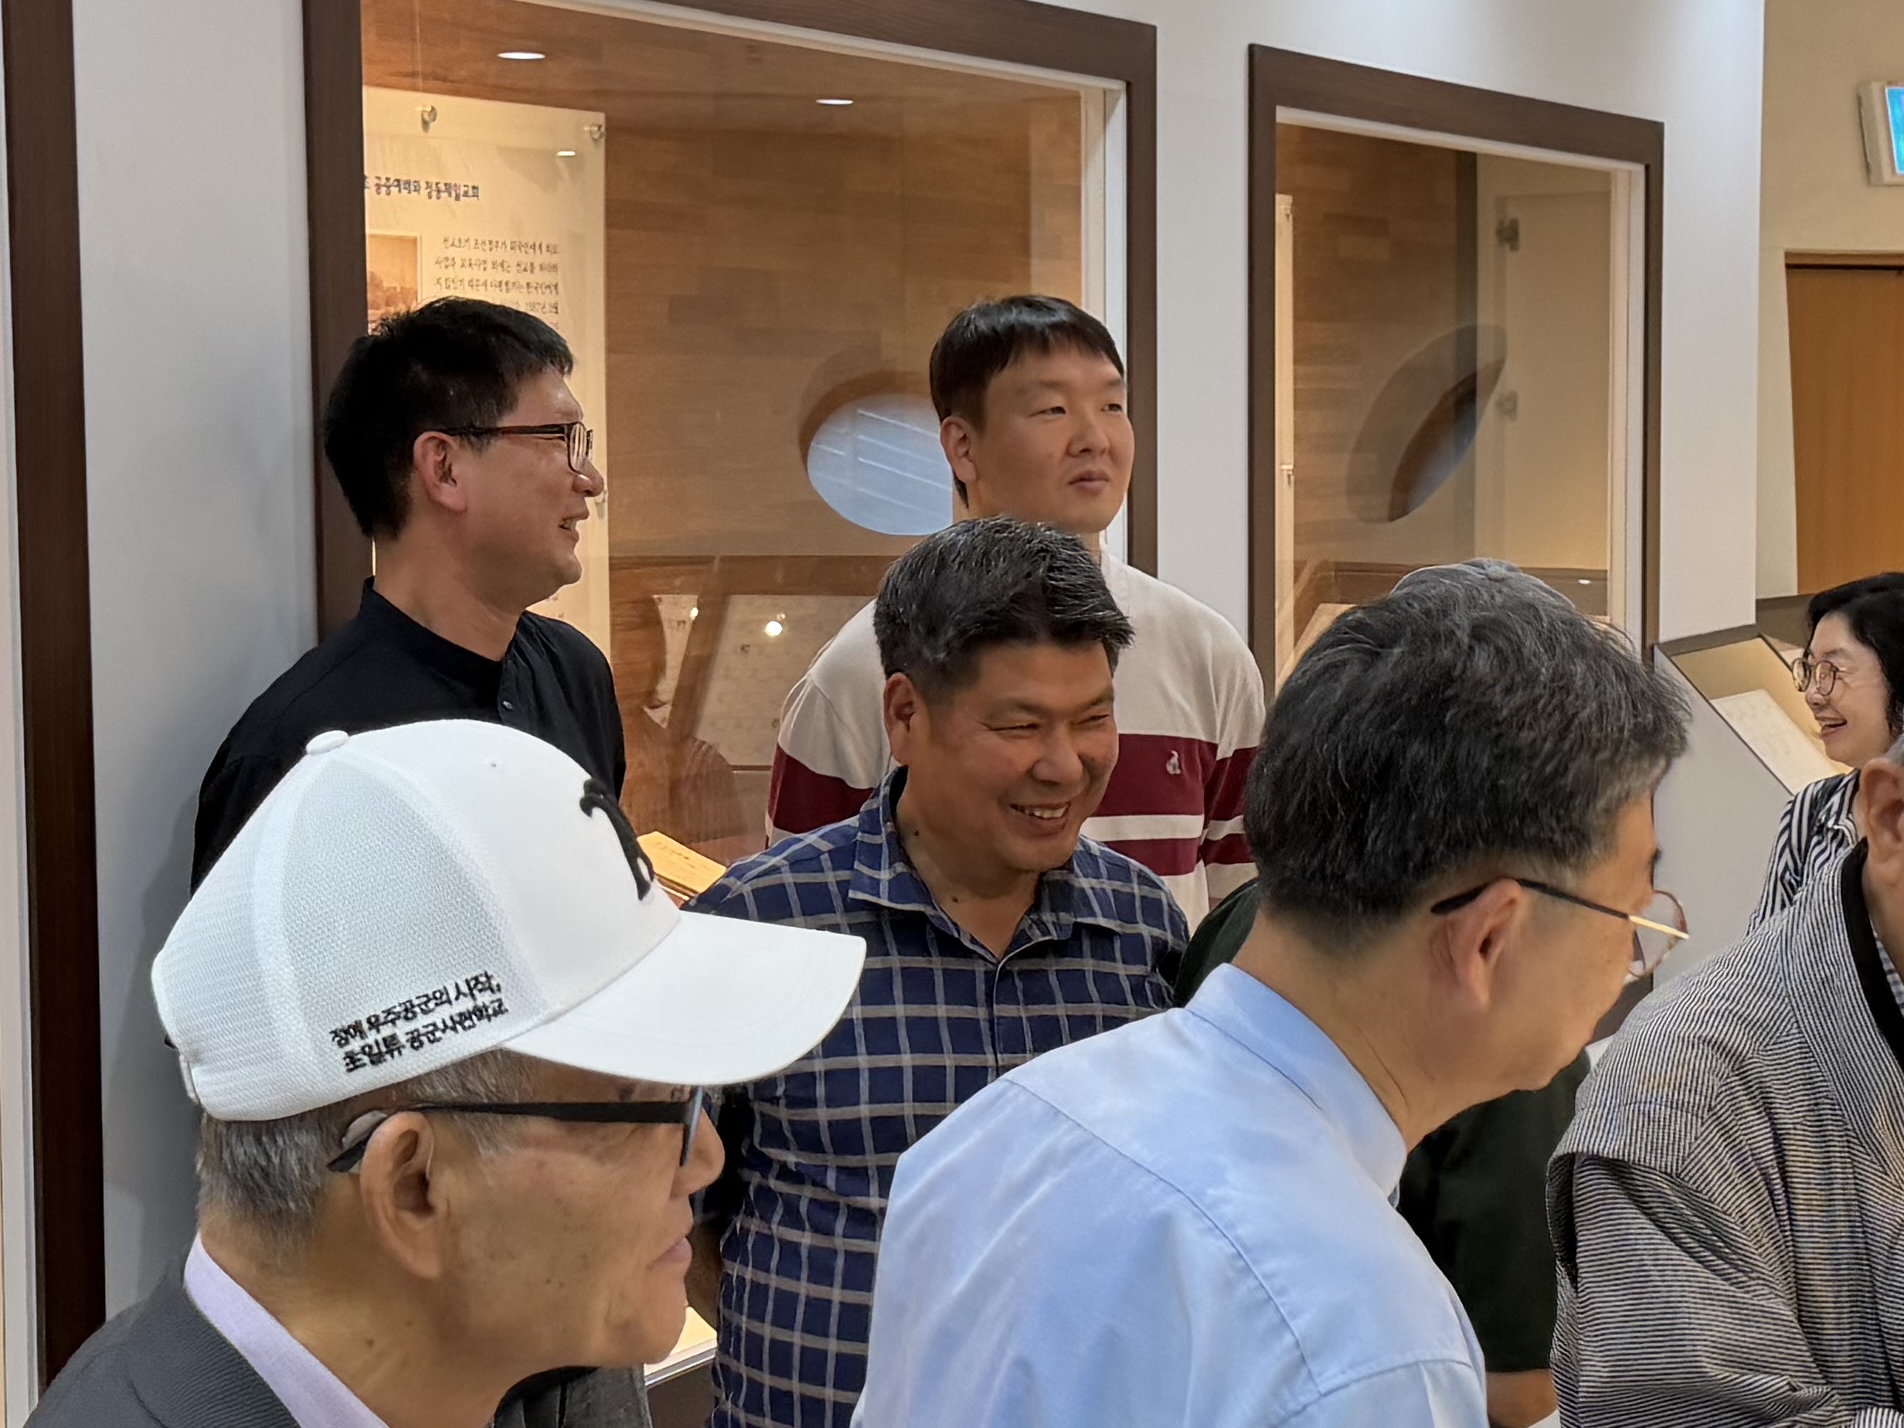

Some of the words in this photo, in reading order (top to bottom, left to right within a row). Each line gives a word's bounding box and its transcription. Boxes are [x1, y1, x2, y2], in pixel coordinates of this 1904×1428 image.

[342, 1033, 407, 1072] 초일류
[404, 997, 509, 1051] 공군사관학교
[365, 985, 453, 1035] 우주공군의
[454, 970, 502, 1002] 시작,
